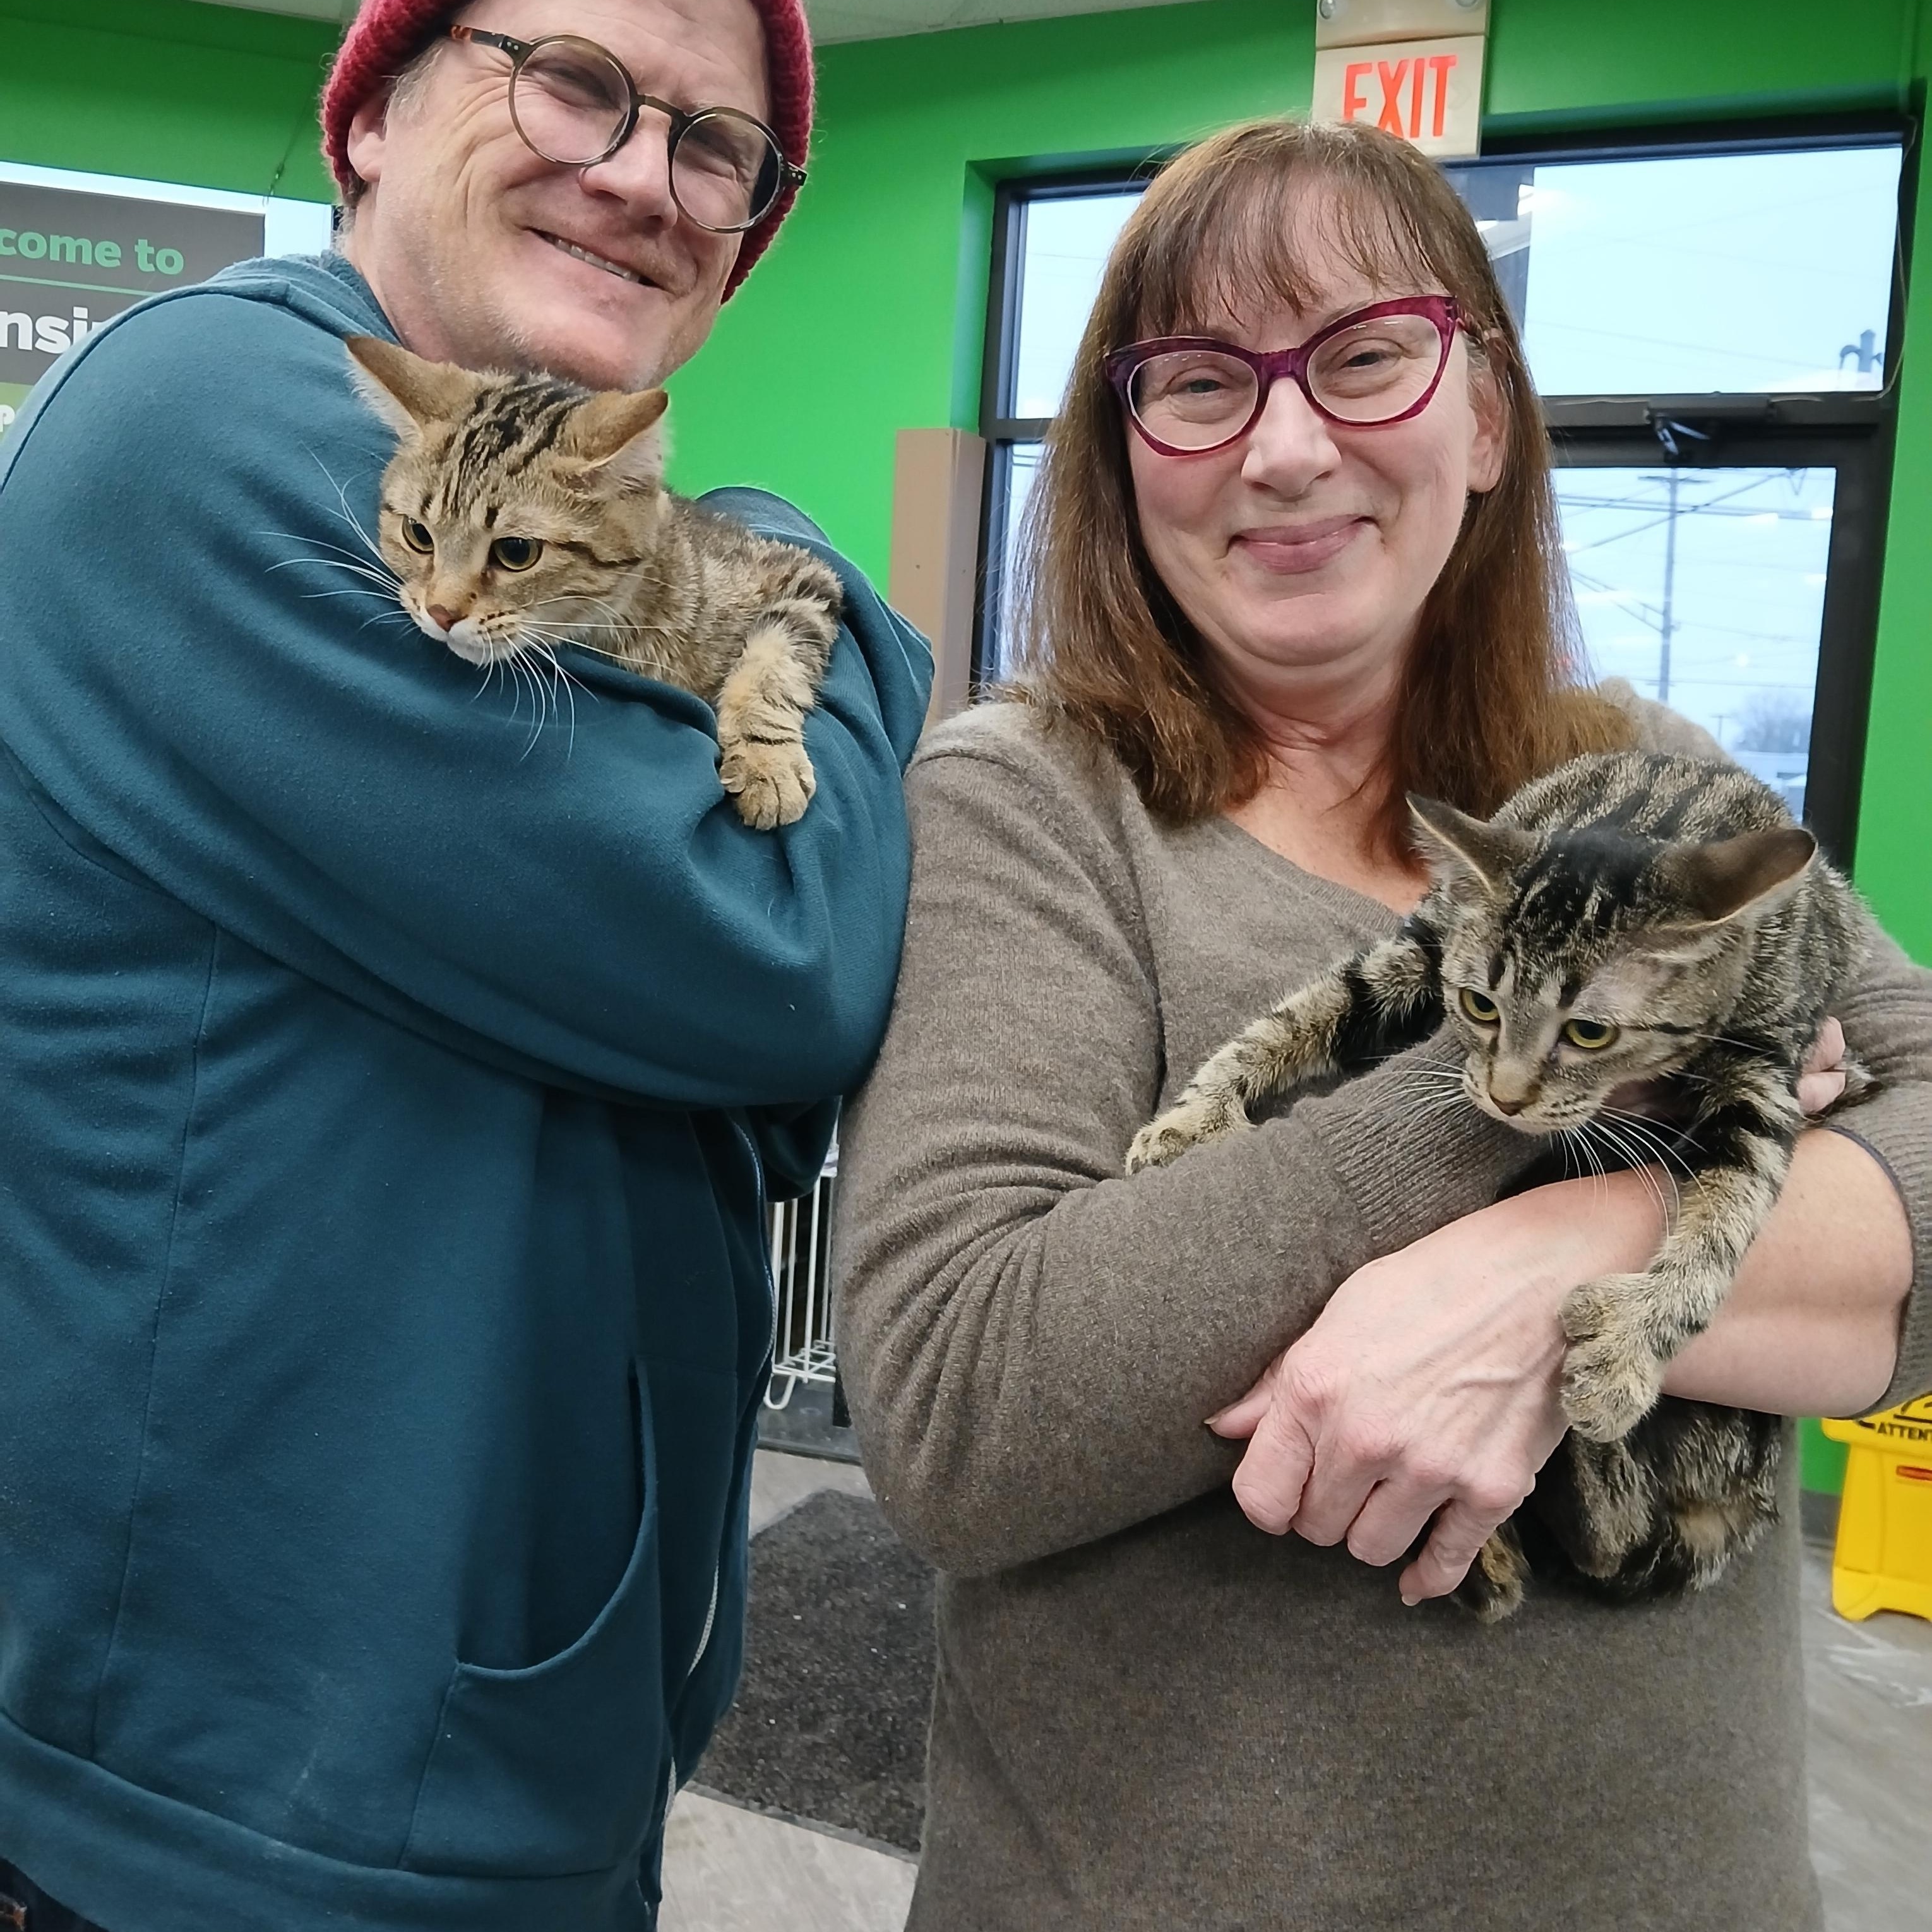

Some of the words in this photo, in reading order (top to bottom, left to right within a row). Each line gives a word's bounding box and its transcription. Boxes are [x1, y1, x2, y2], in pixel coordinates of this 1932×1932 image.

[1343, 54, 1457, 138] EXIT
[134, 239, 184, 275] to
[0, 306, 104, 354] nsi
